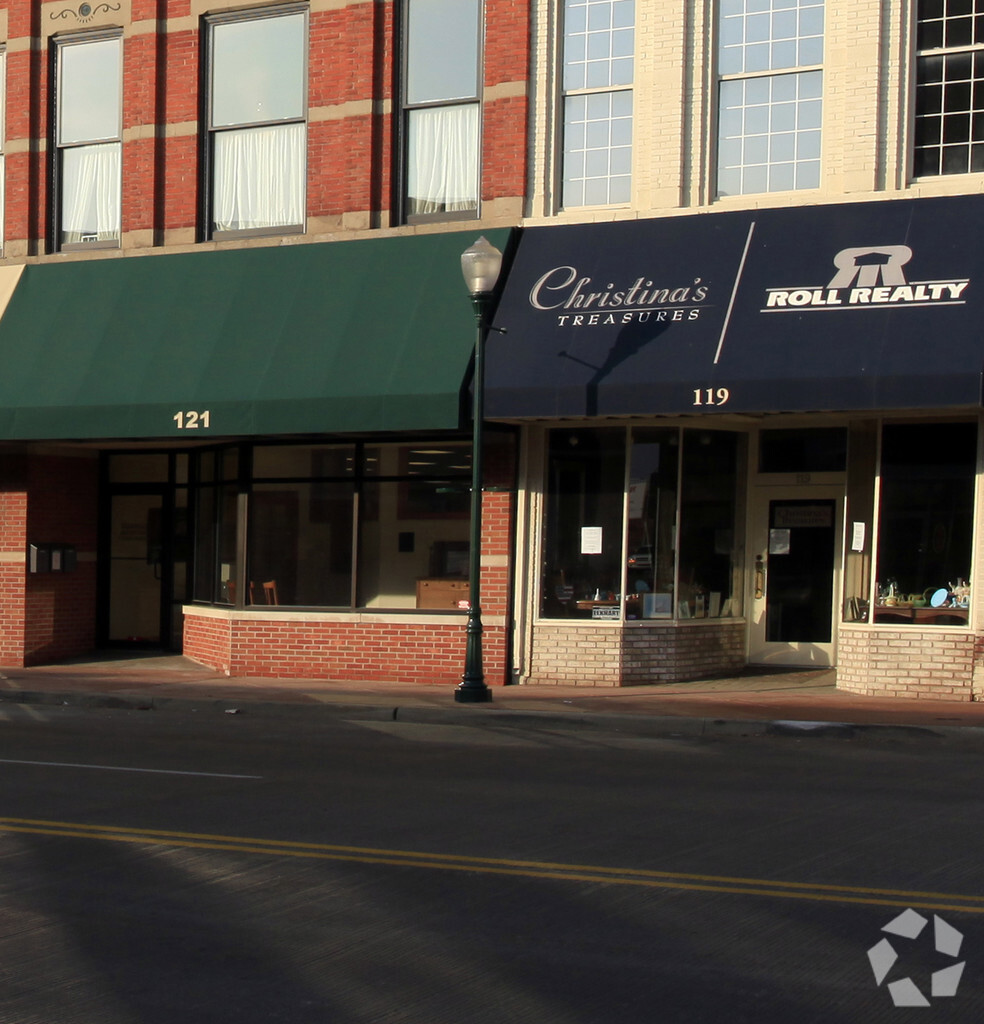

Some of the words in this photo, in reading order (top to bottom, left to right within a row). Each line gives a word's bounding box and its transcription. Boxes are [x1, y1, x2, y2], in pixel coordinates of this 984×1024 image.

[529, 265, 709, 310] Christina's
[766, 289, 843, 307] ROLL
[849, 282, 969, 304] REALTY
[557, 309, 701, 327] TREASURES
[693, 387, 730, 406] 119
[173, 410, 210, 429] 121
